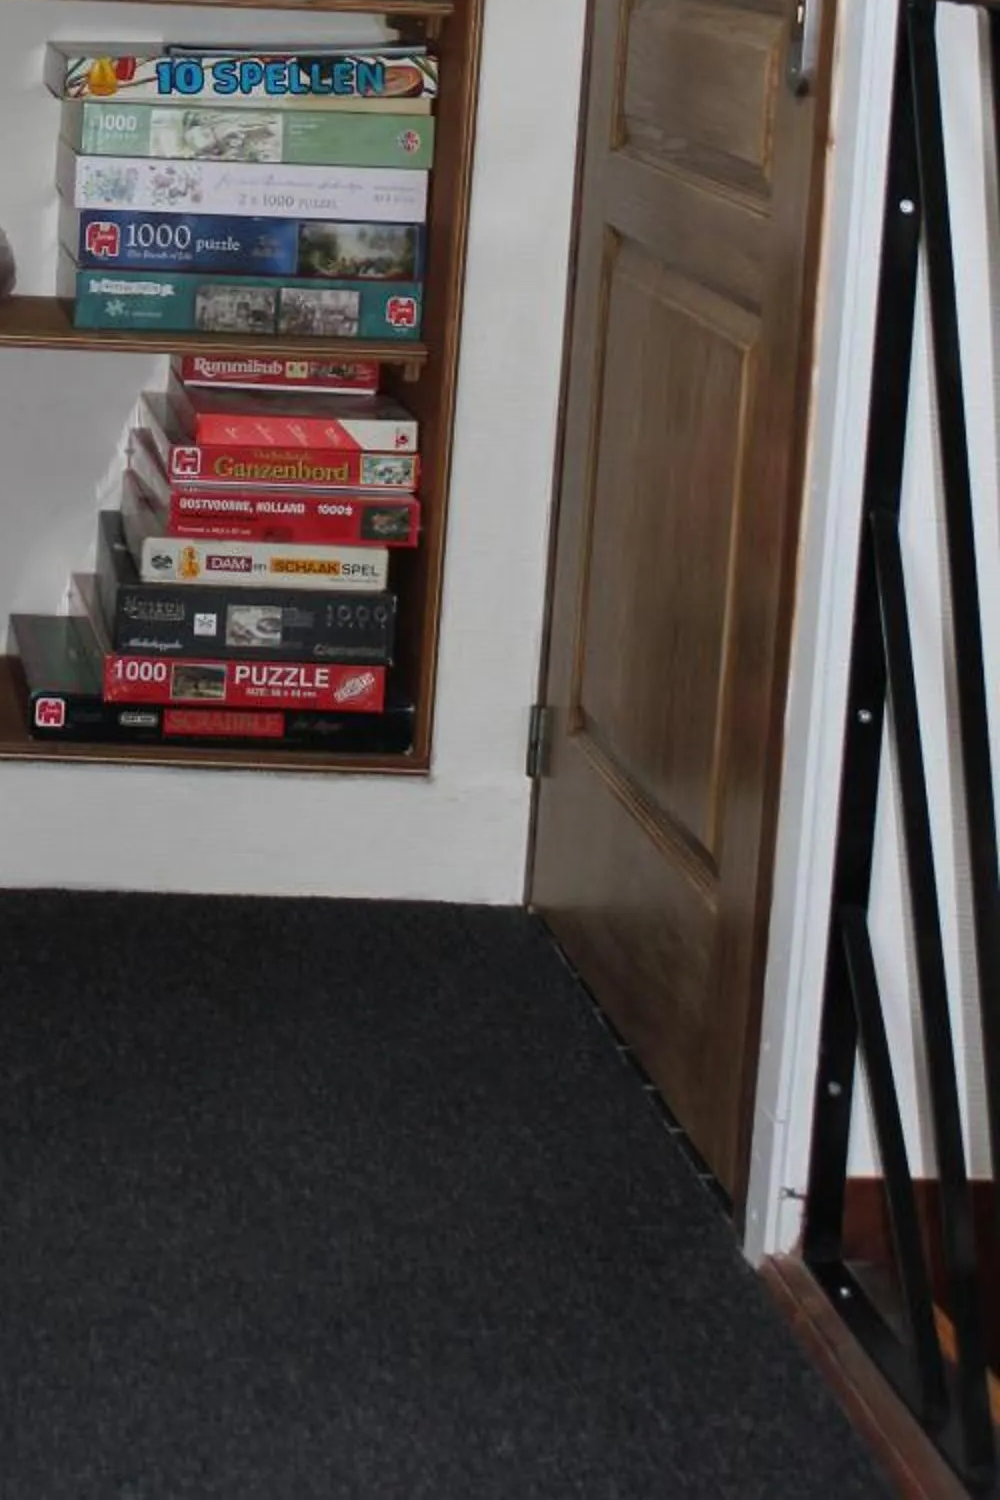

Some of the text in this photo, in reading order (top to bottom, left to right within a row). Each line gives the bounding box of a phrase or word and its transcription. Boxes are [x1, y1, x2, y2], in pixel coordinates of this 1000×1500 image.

[155, 59, 388, 97] 10 SPELLEN
[95, 113, 137, 132] 1000
[262, 194, 295, 208] 1000
[125, 223, 191, 250] 1000
[195, 236, 241, 253] puzzle
[193, 357, 284, 378] Rummikub
[213, 455, 350, 483] Ganzenbord
[341, 563, 380, 578] SPEL
[113, 660, 168, 683] 1000
[234, 665, 330, 689] PUZZLE
